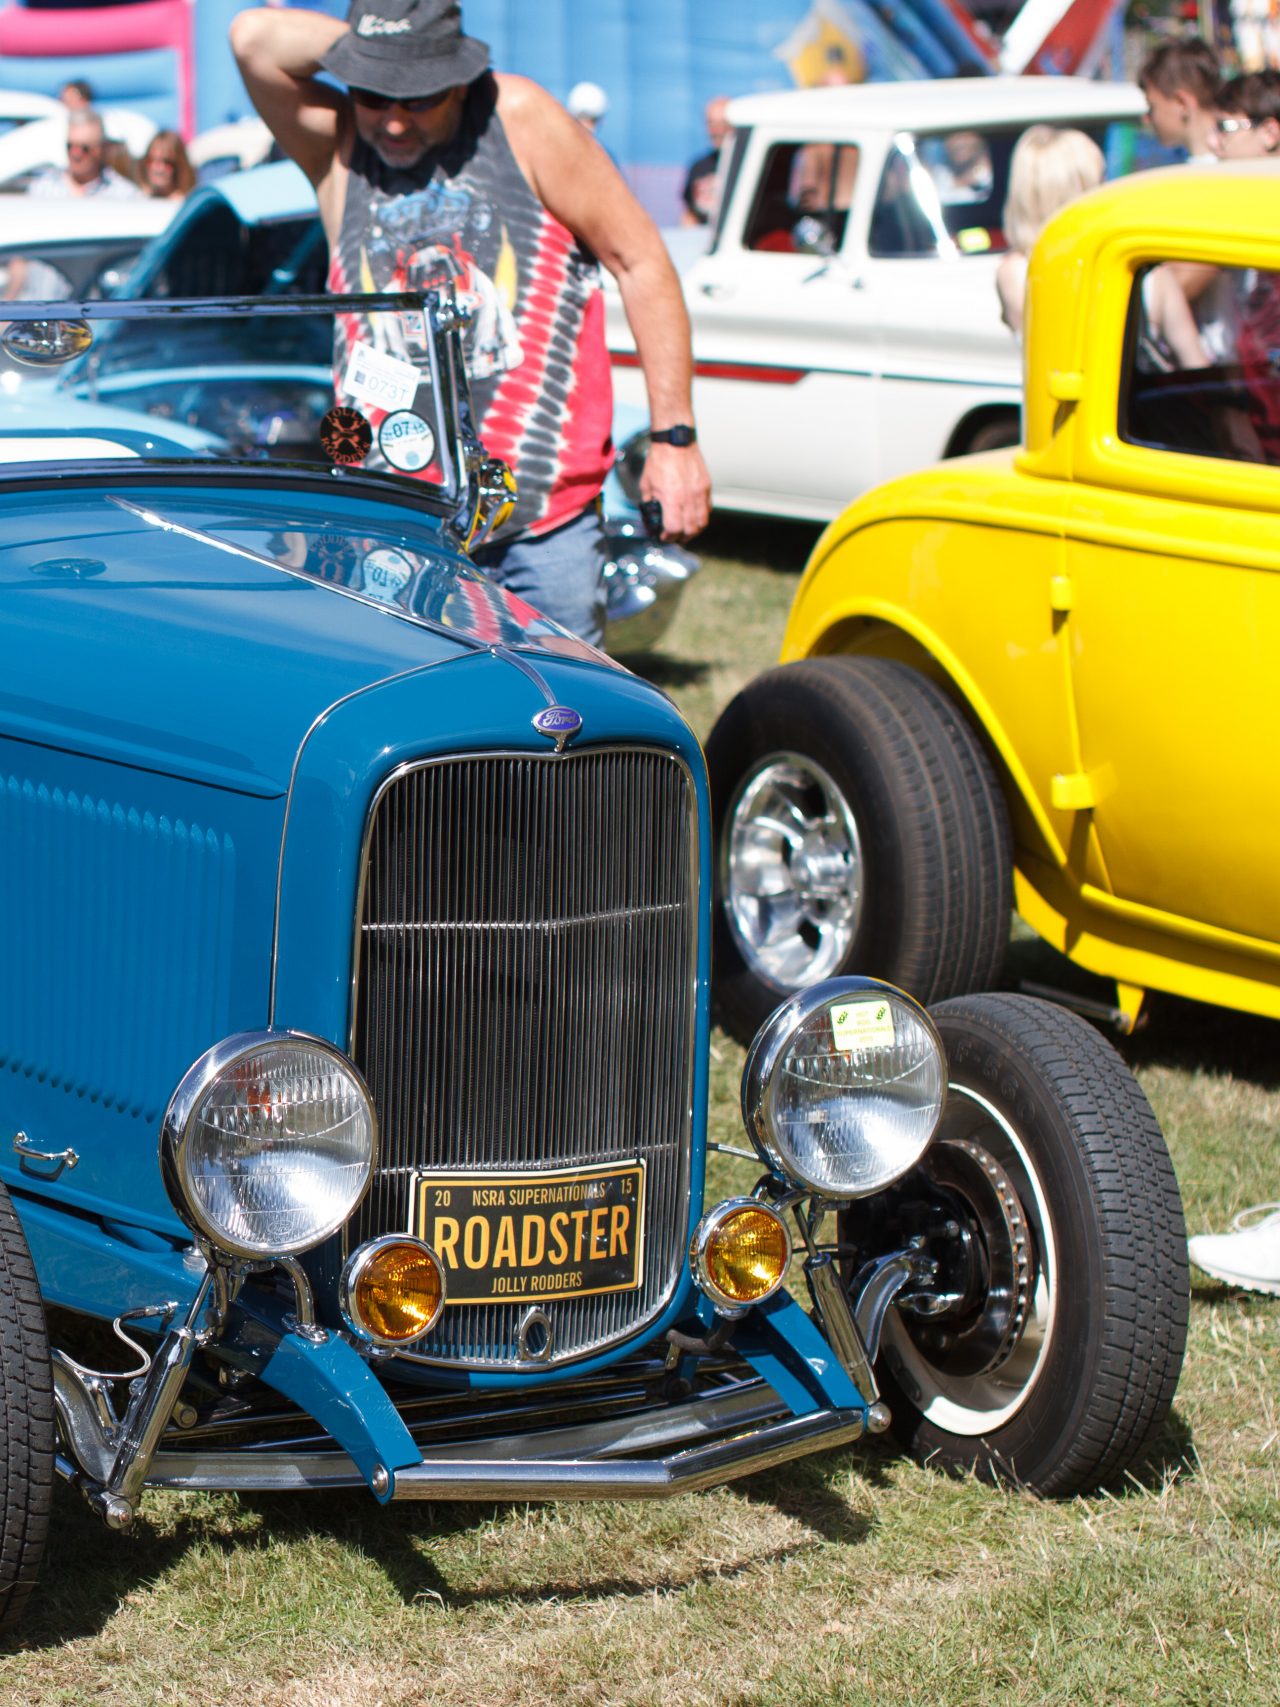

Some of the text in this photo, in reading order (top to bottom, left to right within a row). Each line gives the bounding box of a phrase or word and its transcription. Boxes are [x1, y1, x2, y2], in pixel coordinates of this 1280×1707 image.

[392, 421, 409, 438] 07
[542, 709, 577, 727] Ford
[434, 1178, 632, 1207] 20 NSRA SUPERNATIONALS 15
[434, 1205, 630, 1270] ROADSTER
[491, 1271, 583, 1294] JOLLY RODDERS
